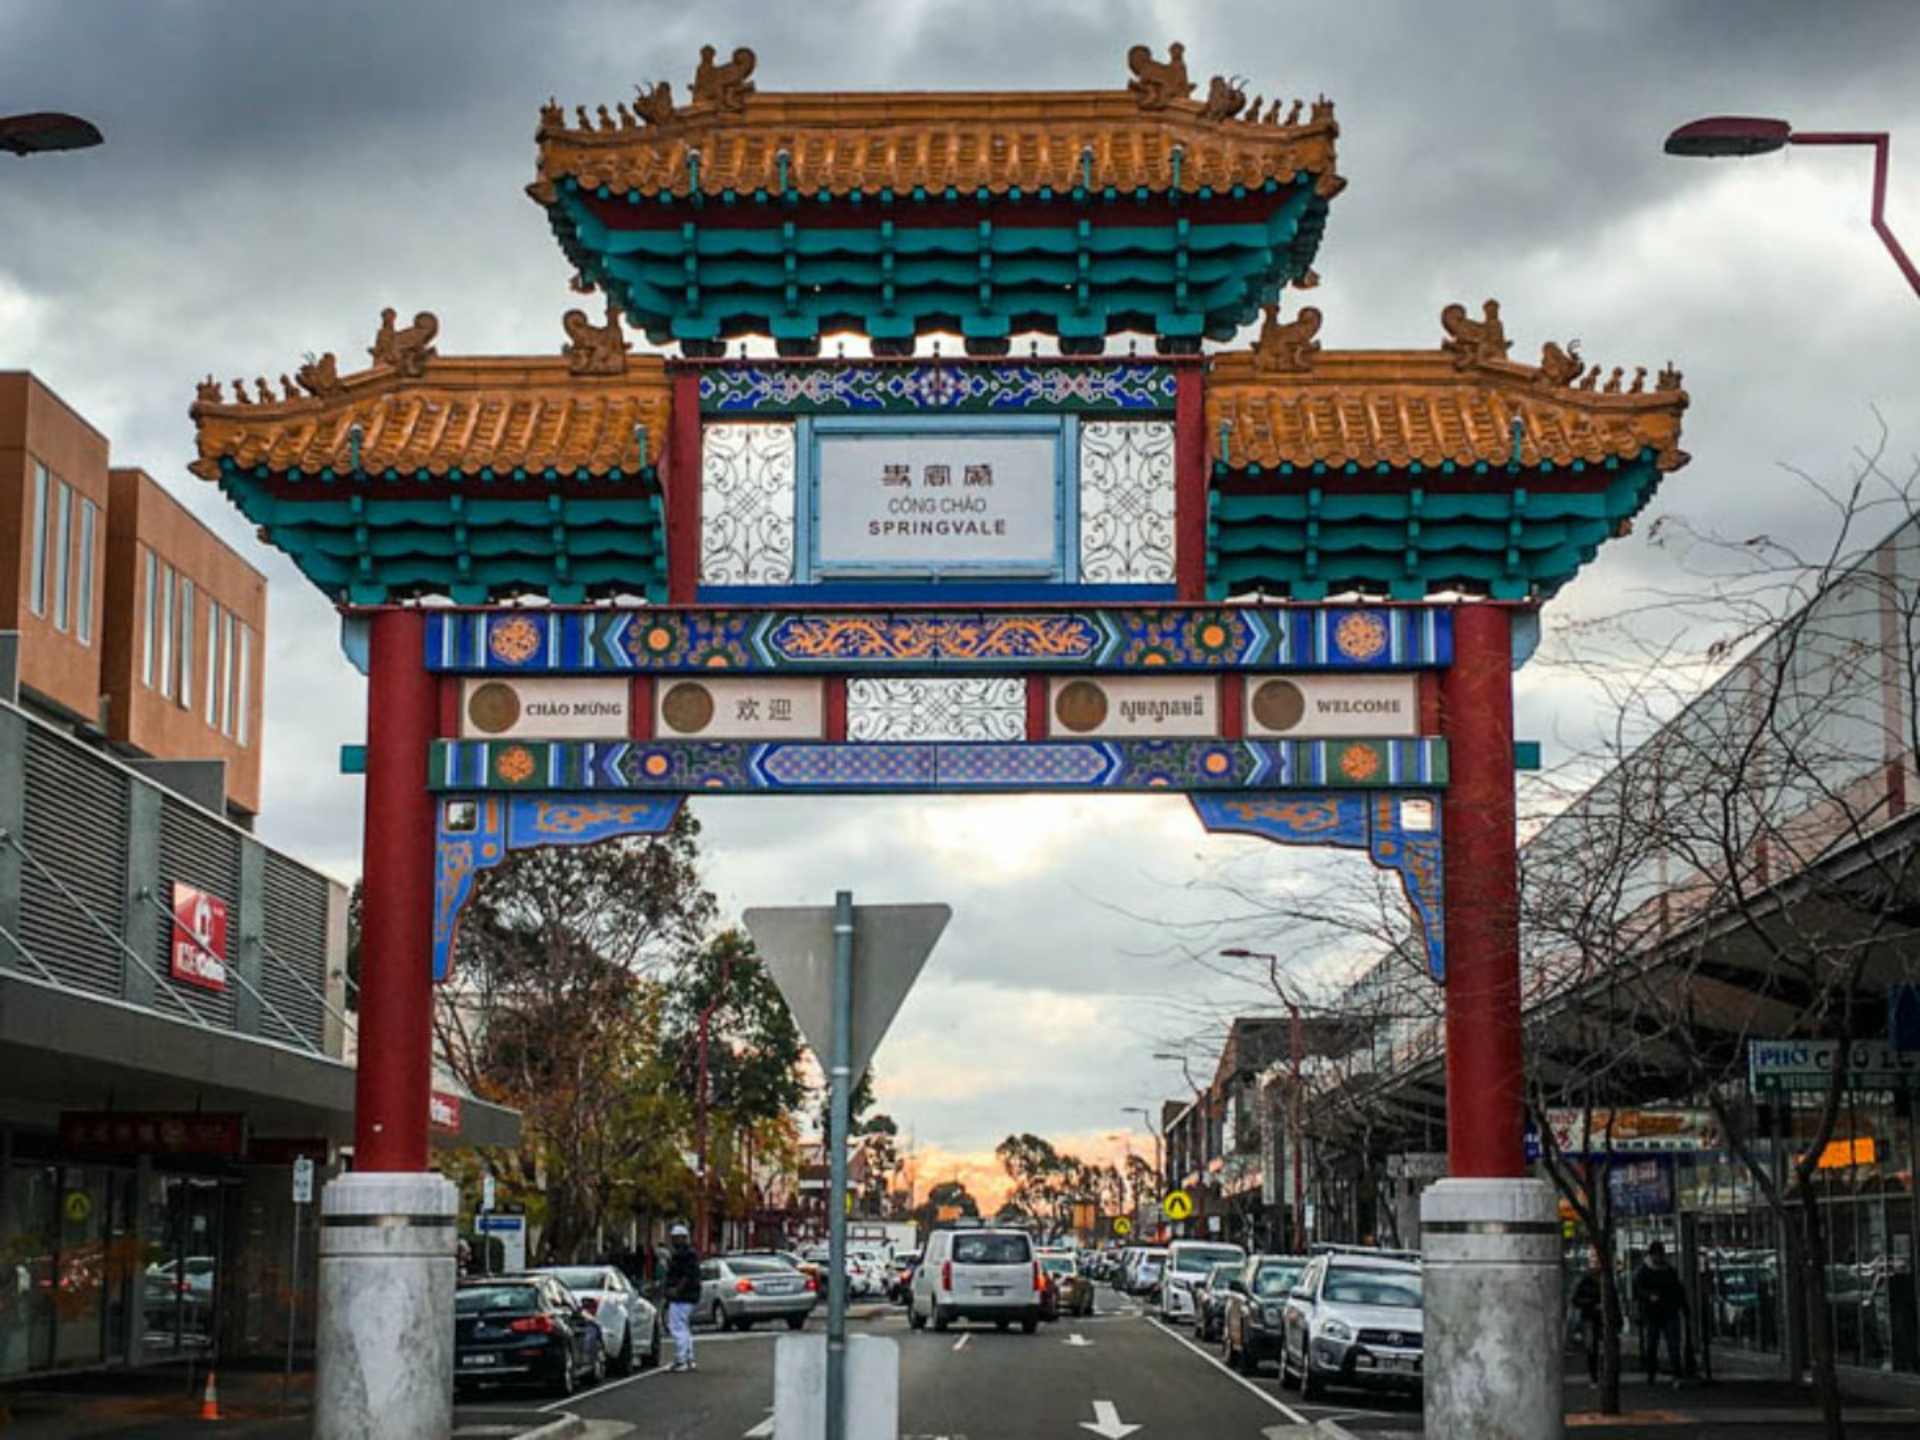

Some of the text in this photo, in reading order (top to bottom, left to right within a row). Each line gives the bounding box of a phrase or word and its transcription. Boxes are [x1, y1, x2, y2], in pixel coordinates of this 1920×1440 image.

[869, 520, 1007, 536] SPRINGVALE
[735, 697, 794, 721] 欢迎
[1316, 699, 1401, 714] WELCOME
